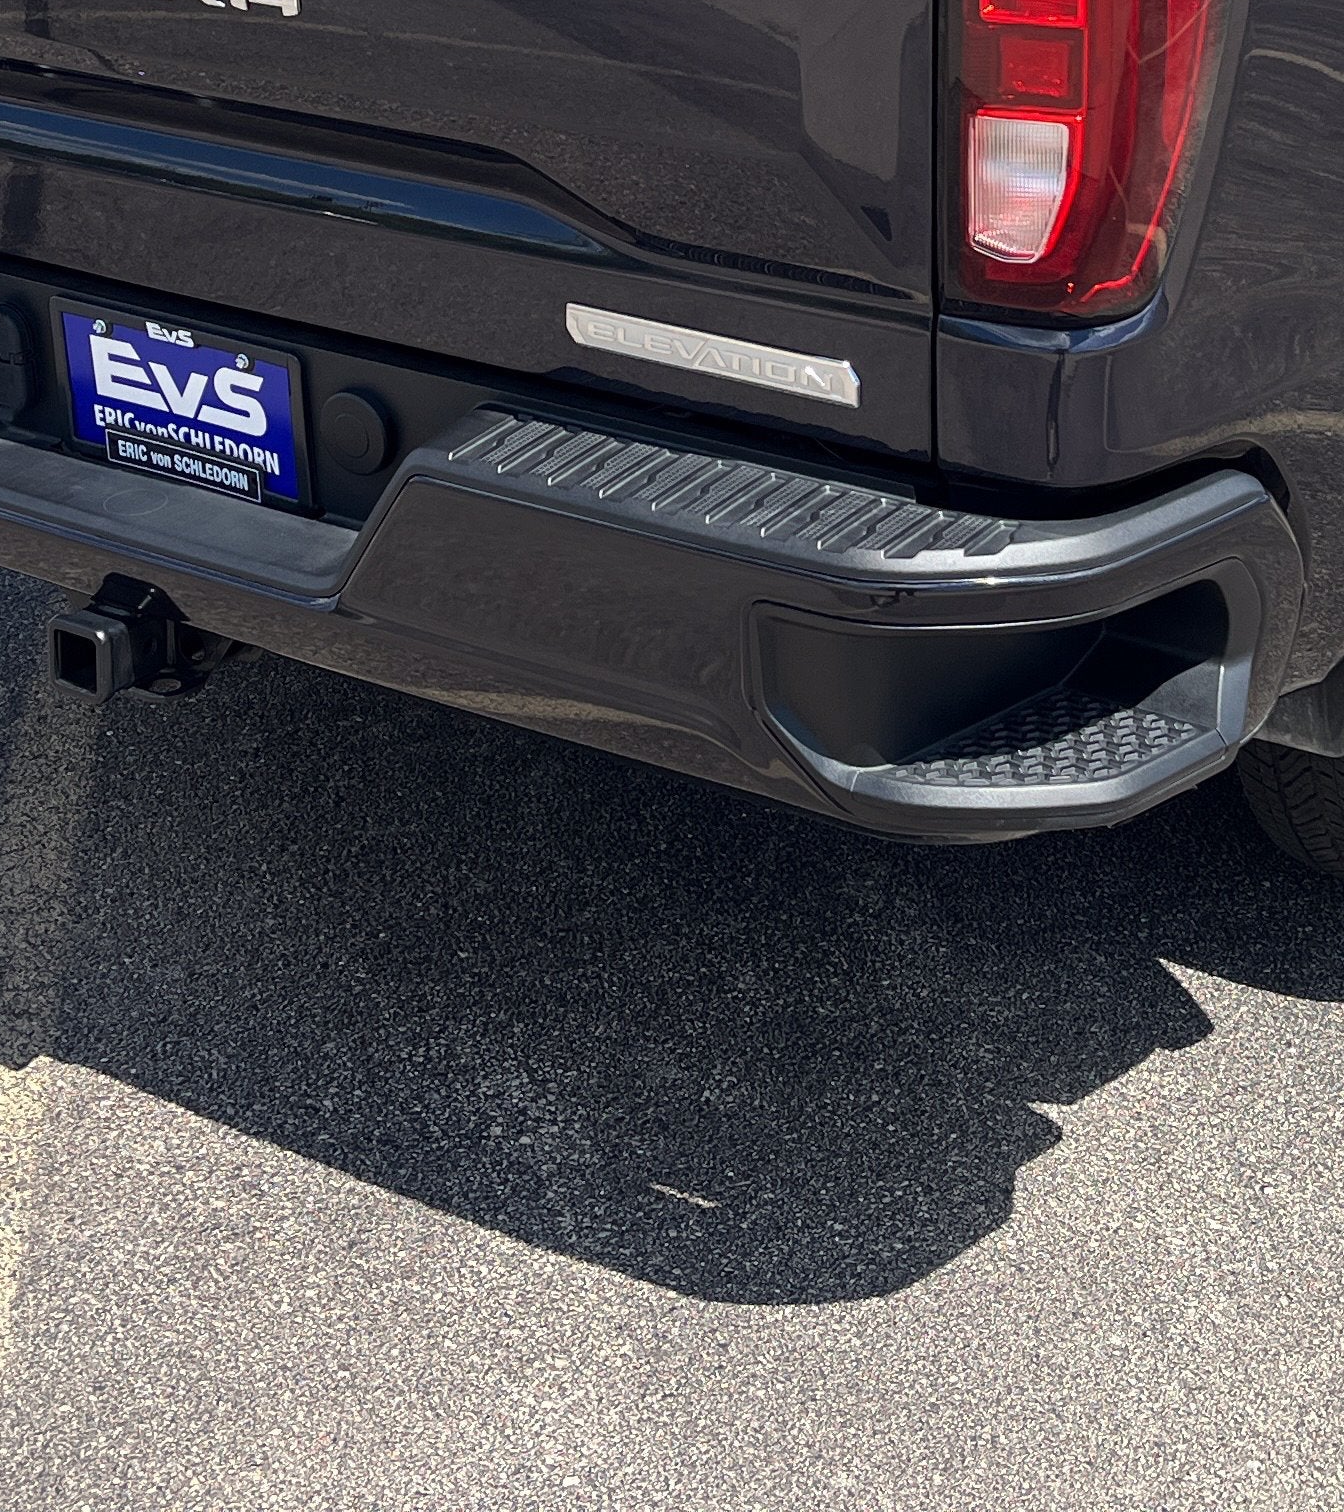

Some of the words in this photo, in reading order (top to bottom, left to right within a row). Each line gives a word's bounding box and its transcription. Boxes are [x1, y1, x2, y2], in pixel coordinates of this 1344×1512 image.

[587, 320, 834, 394] ELEVATION
[94, 404, 135, 428] ERIC
[117, 440, 148, 462] ERIC
[150, 450, 172, 469] von
[174, 454, 249, 491] SCHLEDORN
